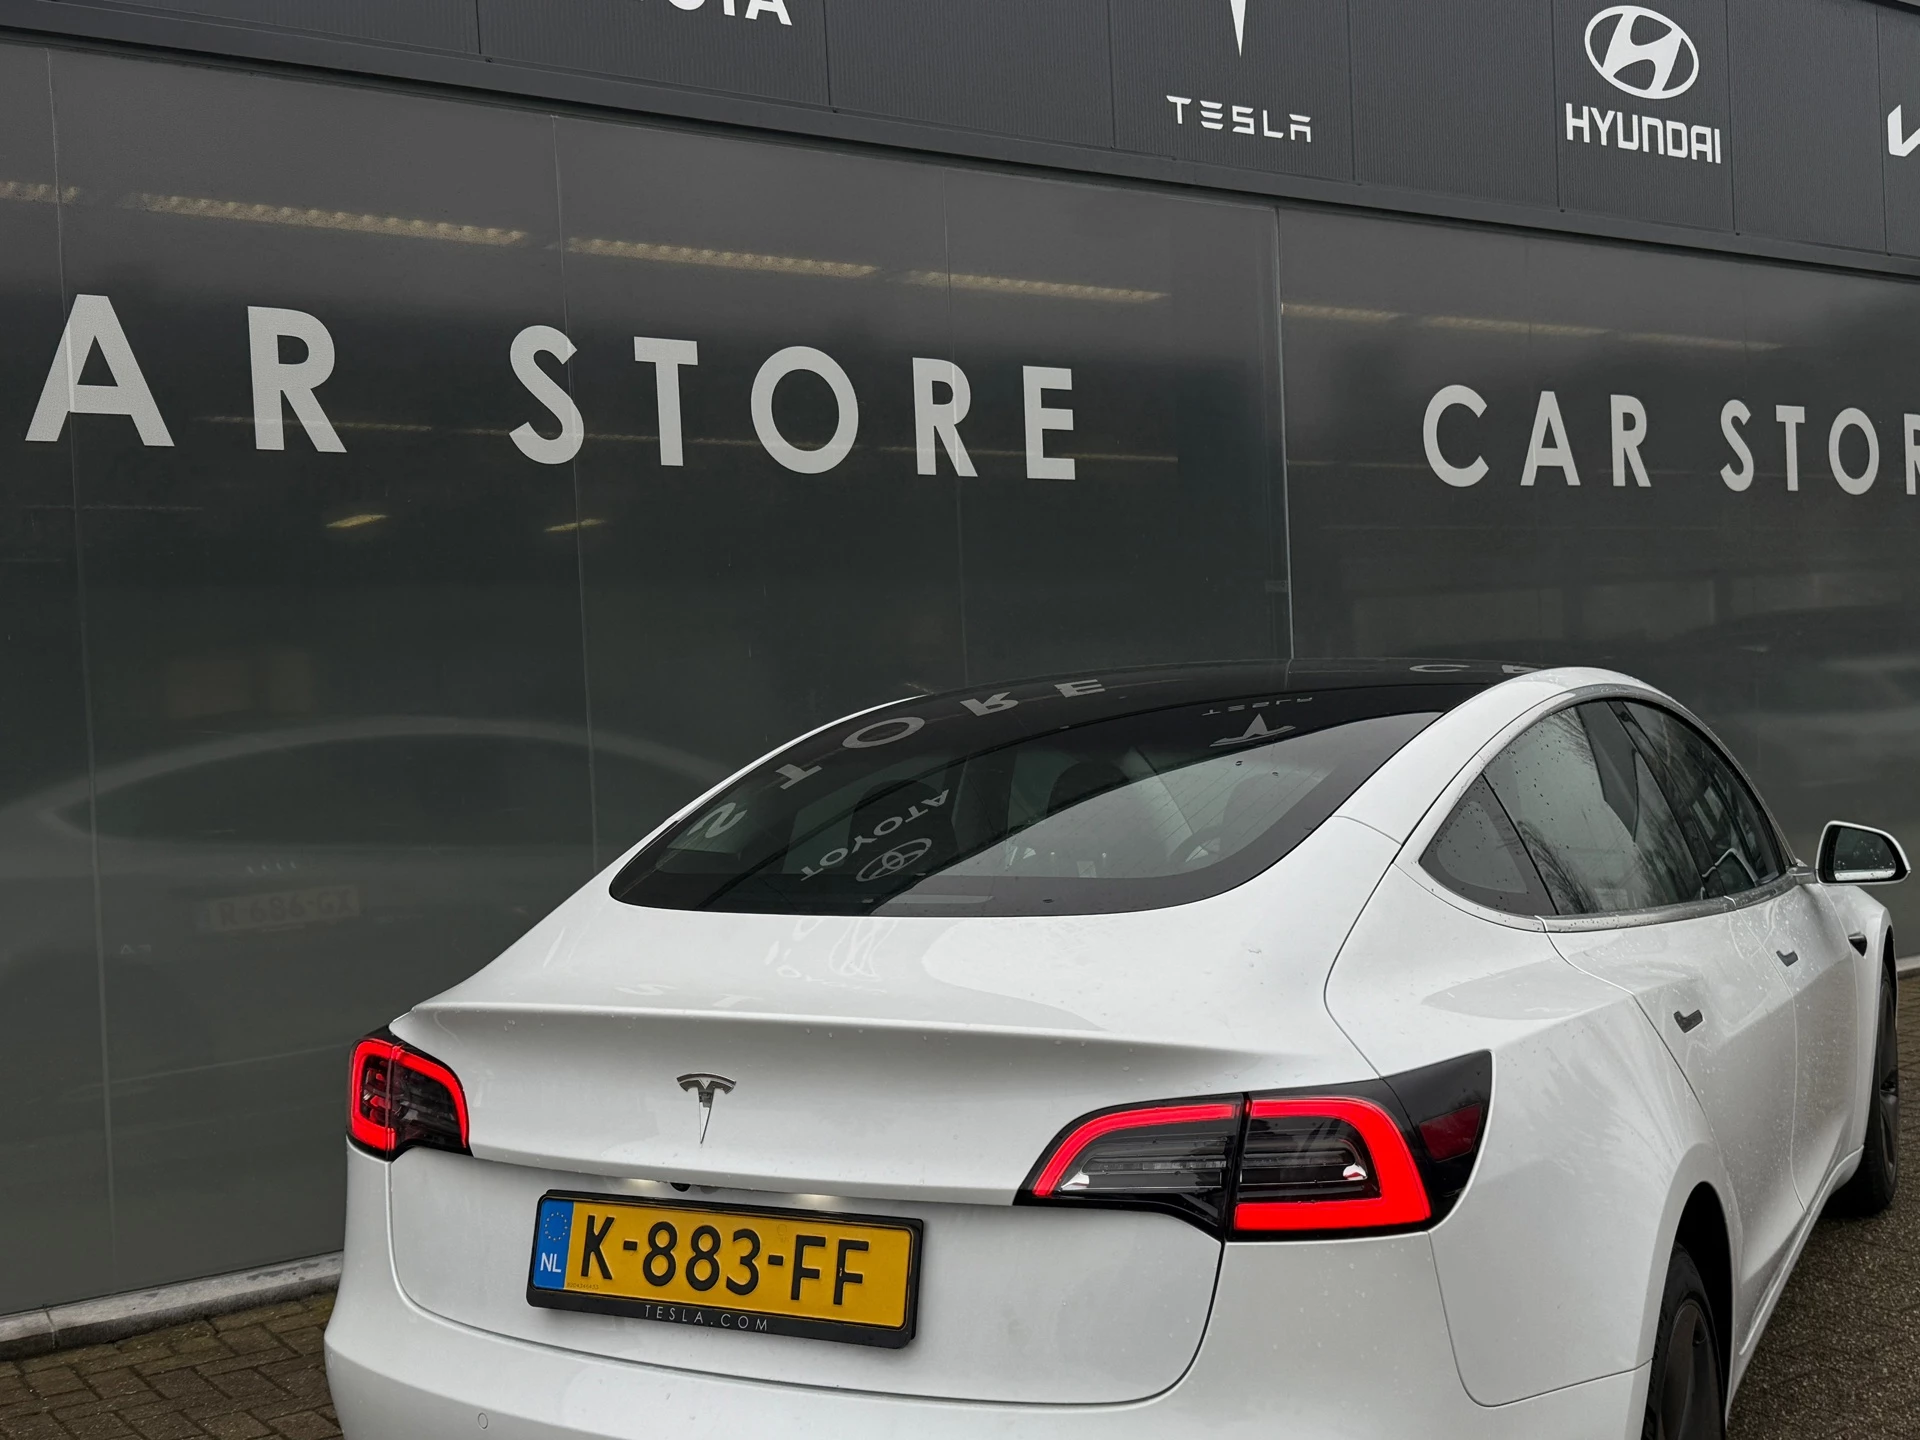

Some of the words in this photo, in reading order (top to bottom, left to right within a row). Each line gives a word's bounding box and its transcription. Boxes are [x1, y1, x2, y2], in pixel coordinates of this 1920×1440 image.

[1166, 94, 1312, 144] TESLA
[1565, 102, 1722, 165] HYUNDAI
[509, 324, 1077, 481] STORE
[1423, 384, 1652, 488] CAR
[540, 1252, 562, 1273] NL
[580, 1214, 869, 1306] K-883-FF
[644, 1304, 769, 1332] TESLA.COM
